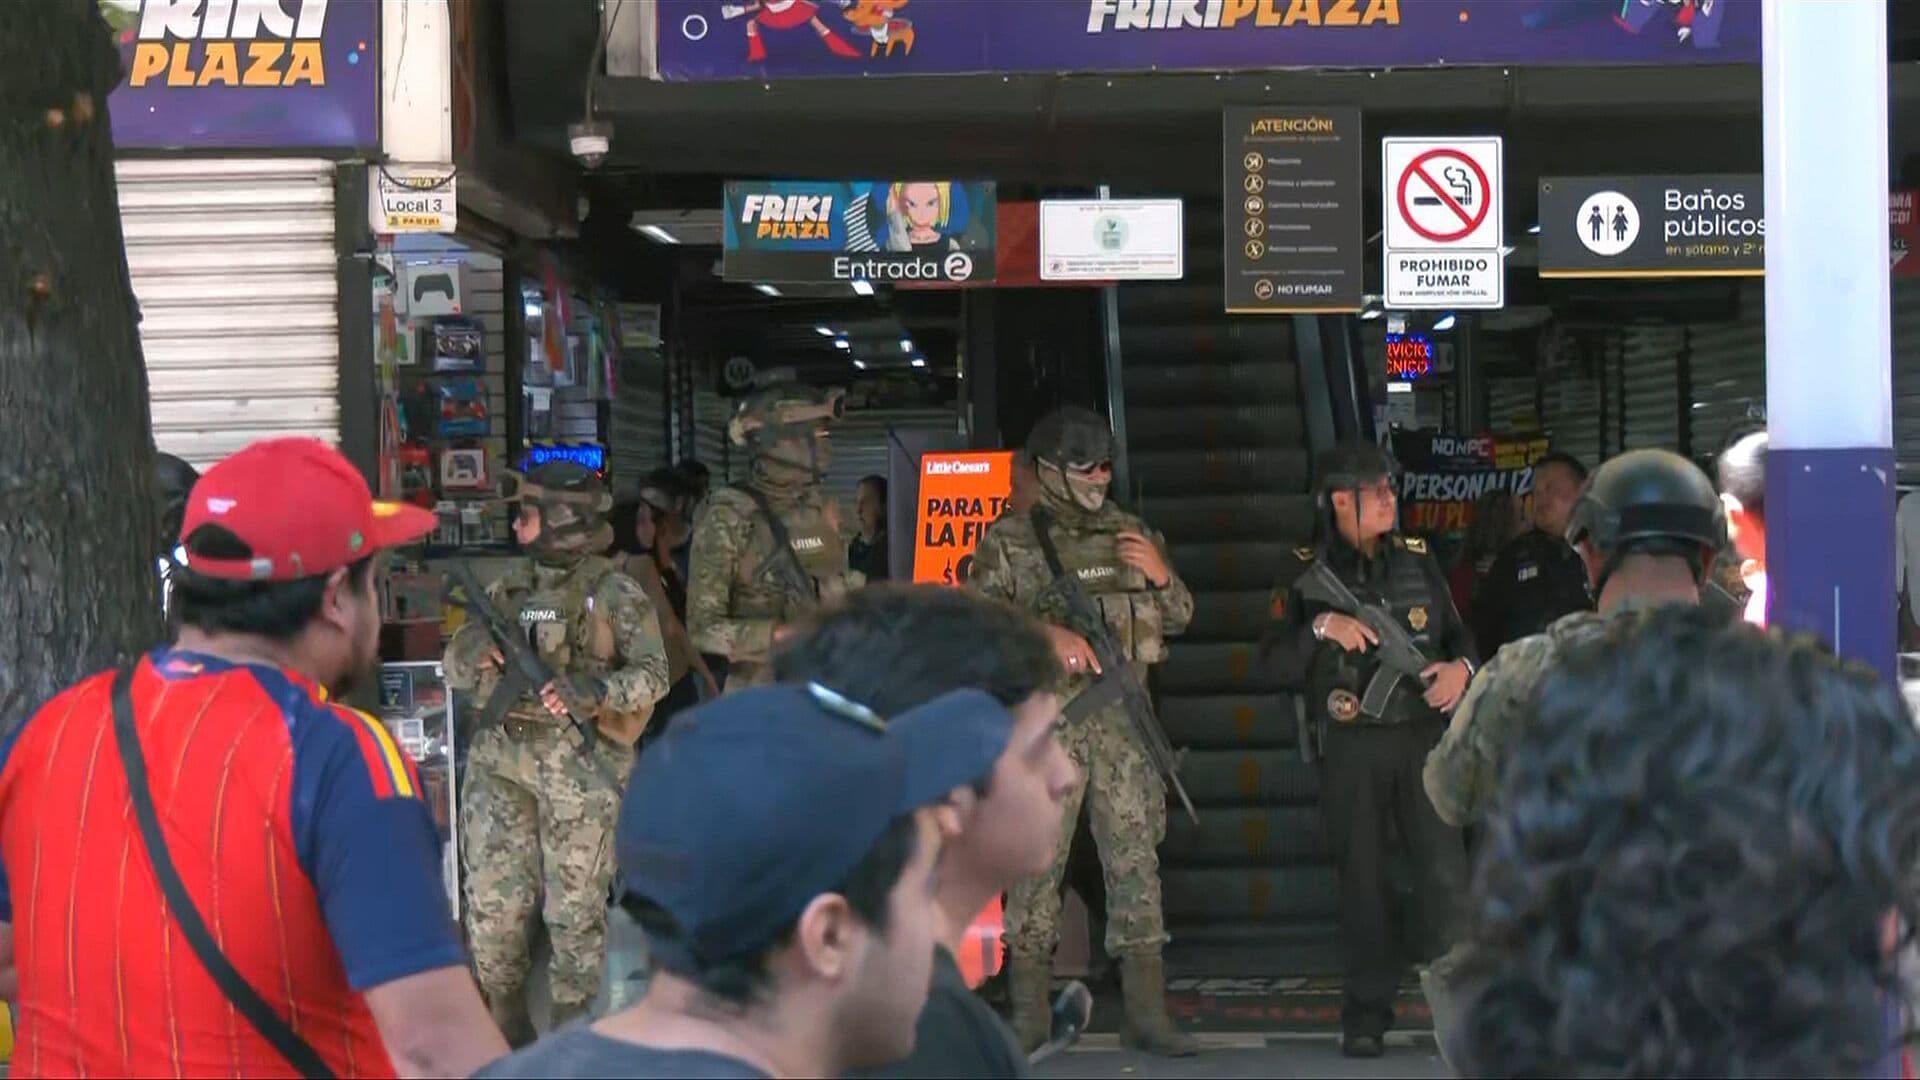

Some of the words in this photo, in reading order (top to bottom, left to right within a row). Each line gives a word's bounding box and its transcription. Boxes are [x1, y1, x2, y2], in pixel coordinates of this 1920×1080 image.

[122, 0, 328, 38] RIKI
[129, 42, 326, 86] PLAZA
[1251, 117, 1333, 135] ¡ATENCIÓN!
[386, 199, 429, 212] Local
[433, 199, 442, 212] 3
[742, 195, 833, 223] FRIKI
[1664, 189, 1746, 211] Baños
[757, 223, 830, 240] PLAZA
[1664, 214, 1765, 242] públicos
[1733, 247, 1740, 257] y
[834, 257, 938, 279] Entrada
[949, 256, 969, 279] 2
[1399, 259, 1488, 272] PROHIBIDO
[1277, 285, 1293, 295] NO
[1295, 284, 1332, 295] FUMAR
[1417, 274, 1470, 287] FUMAR
[927, 498, 983, 516] PARA
[925, 522, 955, 547] LA
[962, 521, 993, 547] FI
